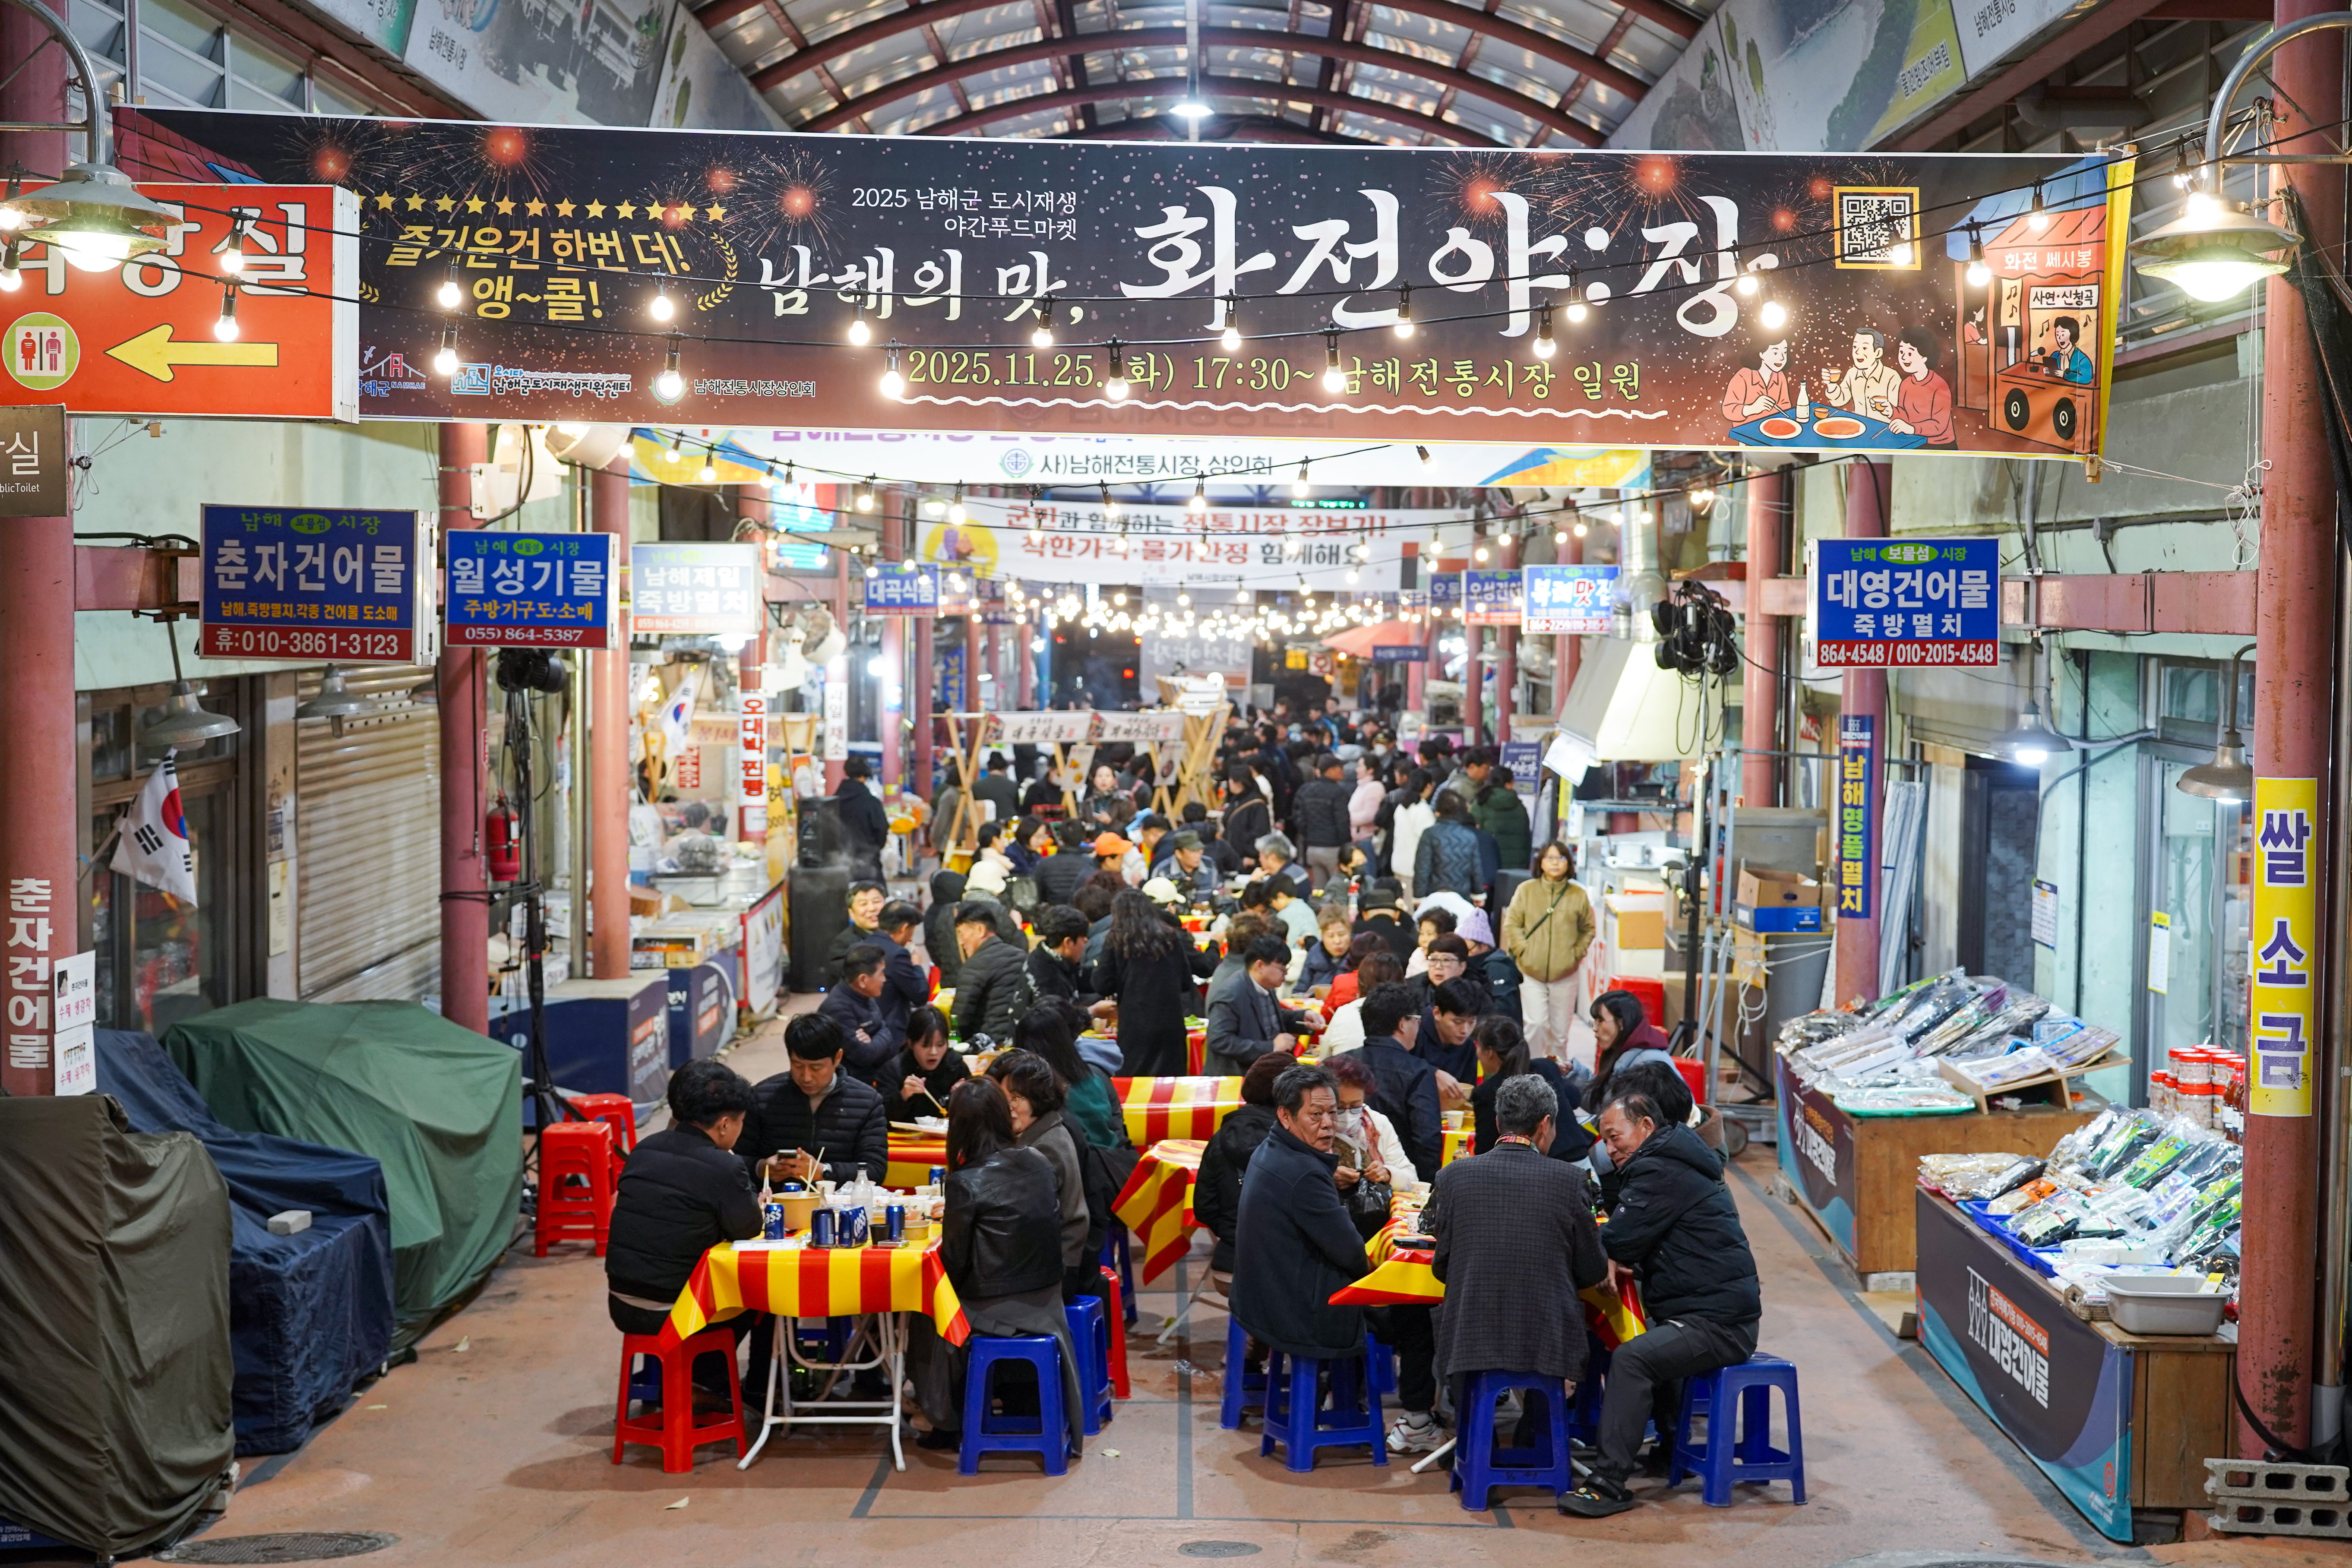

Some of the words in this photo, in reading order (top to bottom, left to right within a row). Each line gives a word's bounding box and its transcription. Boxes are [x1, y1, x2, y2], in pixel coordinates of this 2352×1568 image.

[429, 25, 467, 70] 남해전통시장
[1900, 40, 1951, 99] 물건방조어부림
[852, 188, 907, 208] 2025
[917, 187, 982, 212] 남해군
[989, 190, 1077, 214] 도시재생
[945, 216, 1077, 240] 야간푸드마켓
[385, 225, 540, 270] 즐거운건
[550, 228, 629, 273] 한번
[631, 232, 691, 275] 더!
[2004, 253, 2037, 270] 화전
[2045, 249, 2091, 269] 쎄시봉
[759, 245, 962, 322] 남해의
[996, 250, 1084, 325] 맛,
[473, 276, 603, 320] 앵~콜!
[2033, 289, 2093, 307] 사연·신청곡
[494, 366, 523, 376] 오시다
[1192, 357, 1315, 390] 17:30~
[1574, 361, 1641, 401] 일원
[493, 379, 631, 397] 남해군도시재생지원센터
[694, 379, 816, 397] 남해전통시장상인회
[0, 431, 40, 474] 실
[1040, 455, 1199, 476] 사)남해전통시장
[1208, 455, 1272, 476] 상인회
[241, 513, 281, 531] 남해
[338, 515, 381, 535] 시장
[549, 541, 579, 556] 시장
[1851, 547, 1876, 561] 남해
[1888, 546, 1929, 561] 보물섬
[1941, 547, 1966, 561] 시장
[215, 540, 405, 593] 춘자건어물
[452, 558, 604, 596] 월성기물
[644, 566, 740, 588] 남해제일
[637, 590, 748, 613] 죽방멸치
[1827, 569, 1990, 609] 대영건어물
[324, 605, 358, 620] 건어물
[364, 606, 398, 621] 도소매
[1854, 613, 1961, 638] 죽방멸치
[216, 628, 398, 655] 휴:010-3861-3123
[465, 627, 501, 640] 055)
[506, 628, 583, 642] 864-5387
[1821, 644, 1884, 664] 864-4548
[1897, 643, 1993, 663] 010-2015-4548
[1841, 754, 1866, 913] 남해명품멸치
[2260, 810, 2311, 886] 쌀
[7, 878, 53, 1069] 춘자건어물
[765, 1209, 782, 1224] ass
[1989, 1312, 2049, 1410] 대영건어물
